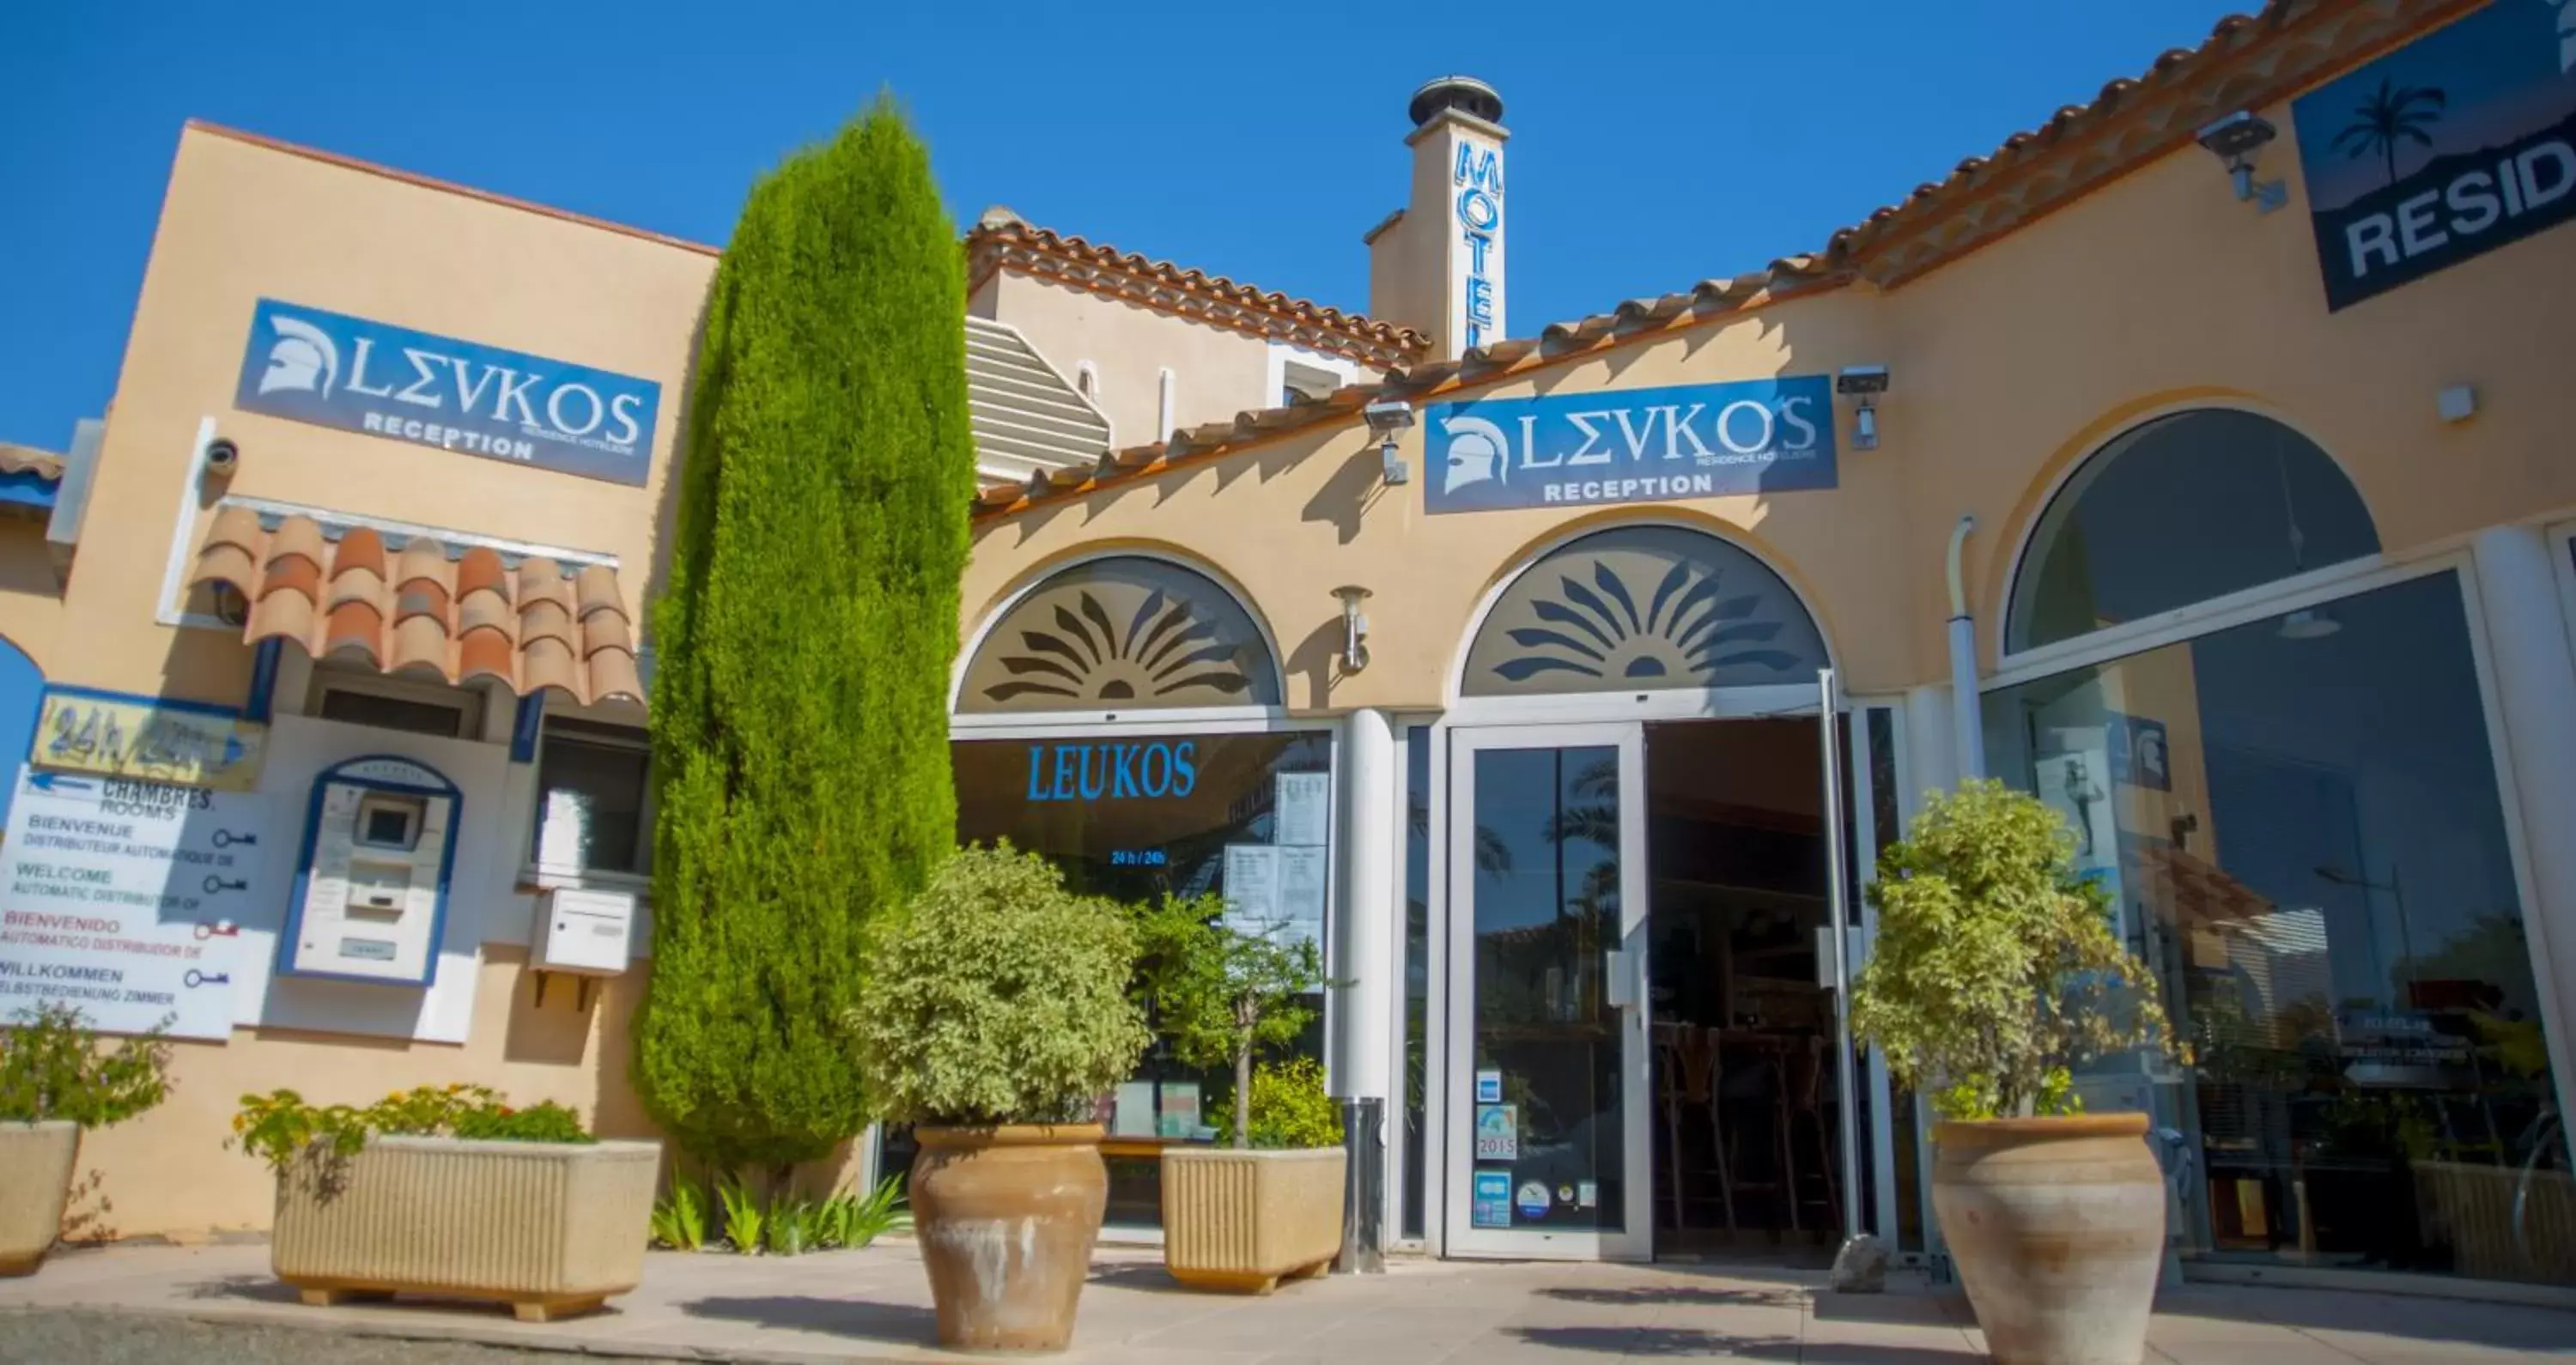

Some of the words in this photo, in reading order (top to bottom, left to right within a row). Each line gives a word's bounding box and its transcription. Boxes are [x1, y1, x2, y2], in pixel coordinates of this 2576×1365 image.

[2346, 141, 2576, 278] RESID
[364, 411, 534, 460] RECEPTION
[1545, 473, 1713, 502] RECEPTION
[1026, 741, 1195, 801] LEUKOS
[99, 798, 177, 822] ROOMS
[27, 814, 134, 839] BIENVENUE
[23, 832, 120, 853] DISTRIBUTEUR
[15, 862, 112, 885] WELCOME
[11, 880, 89, 899] AUTOMATIC
[4, 910, 121, 934] BIENVENIDO
[0, 930, 89, 949] AUTOMATICO
[1480, 1138, 1515, 1154] 2015
